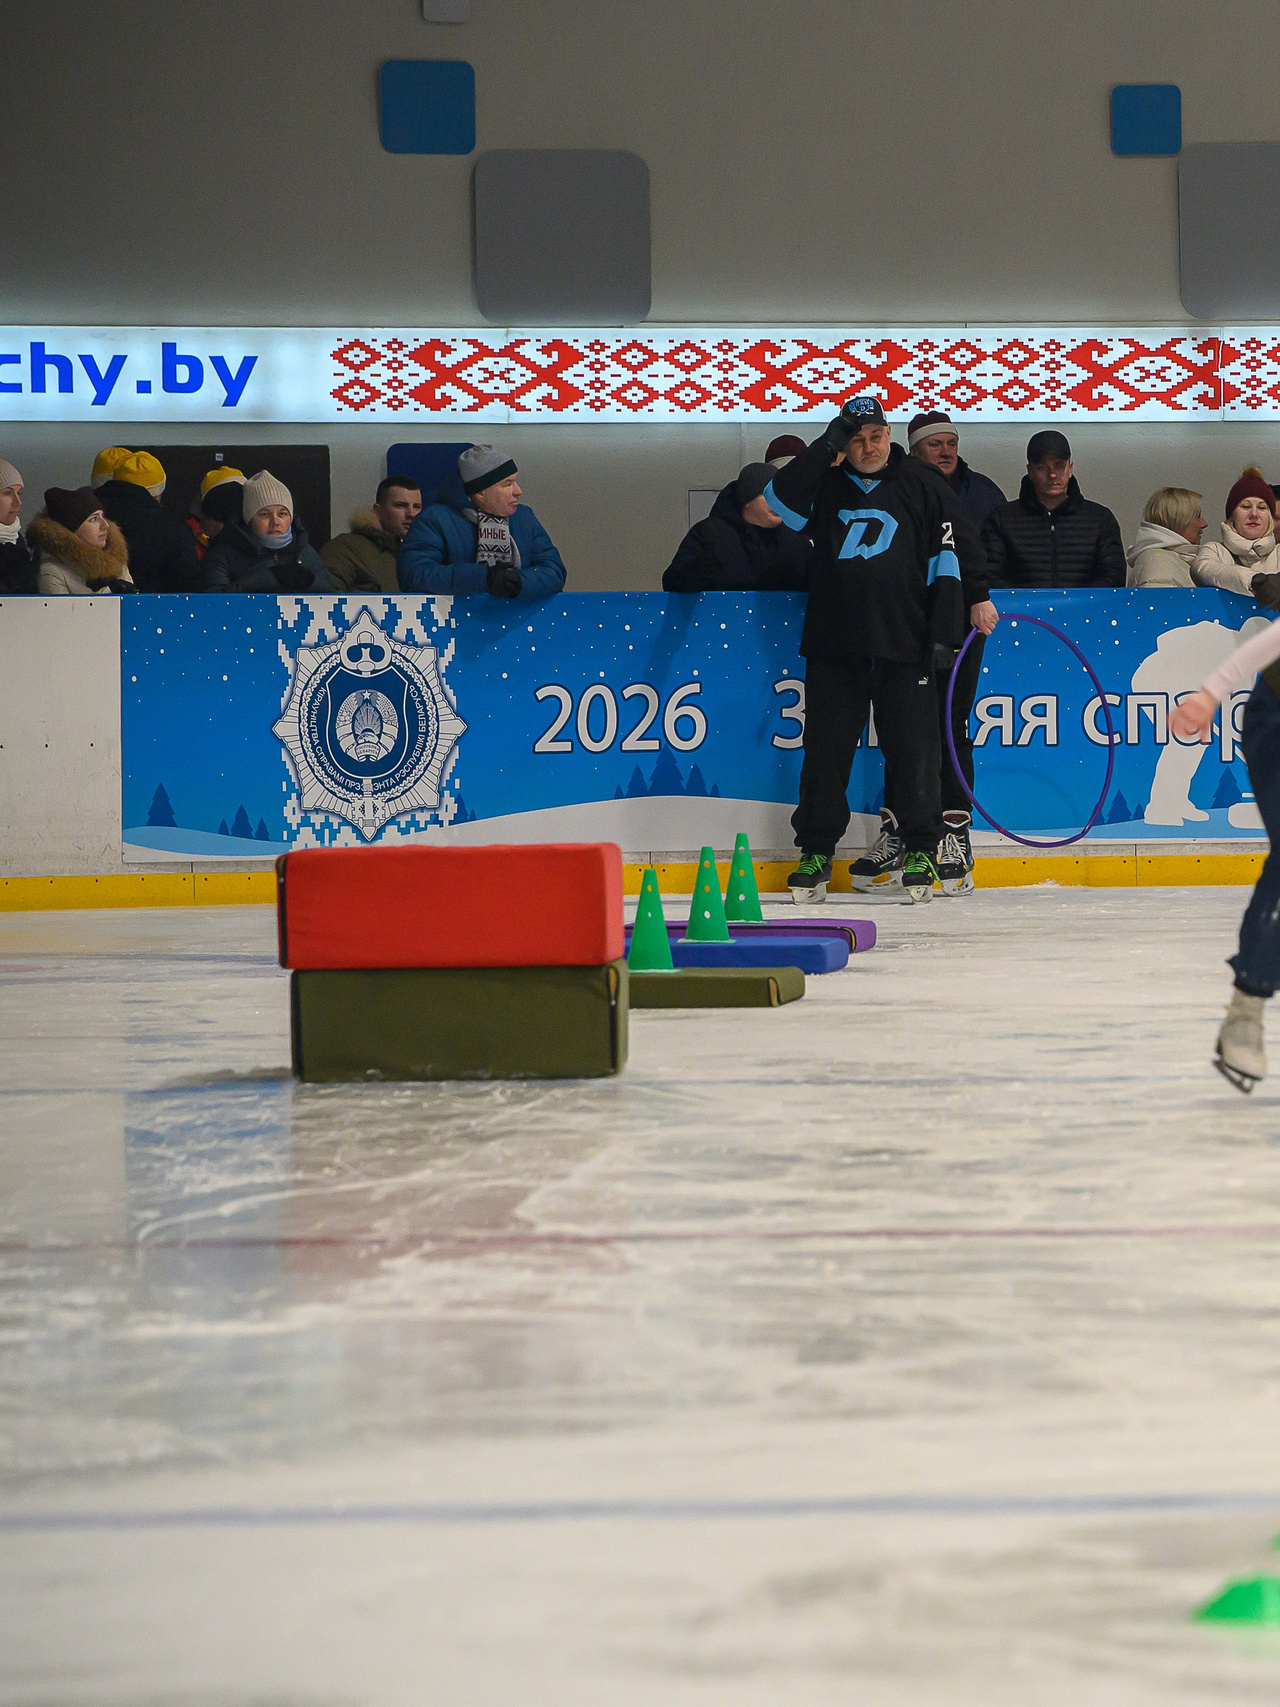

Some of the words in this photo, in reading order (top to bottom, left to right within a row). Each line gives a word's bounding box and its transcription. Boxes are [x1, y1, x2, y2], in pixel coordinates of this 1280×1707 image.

[0, 342, 259, 407] chy.by
[533, 682, 708, 753] 2026
[772, 678, 1058, 749] Зяя
